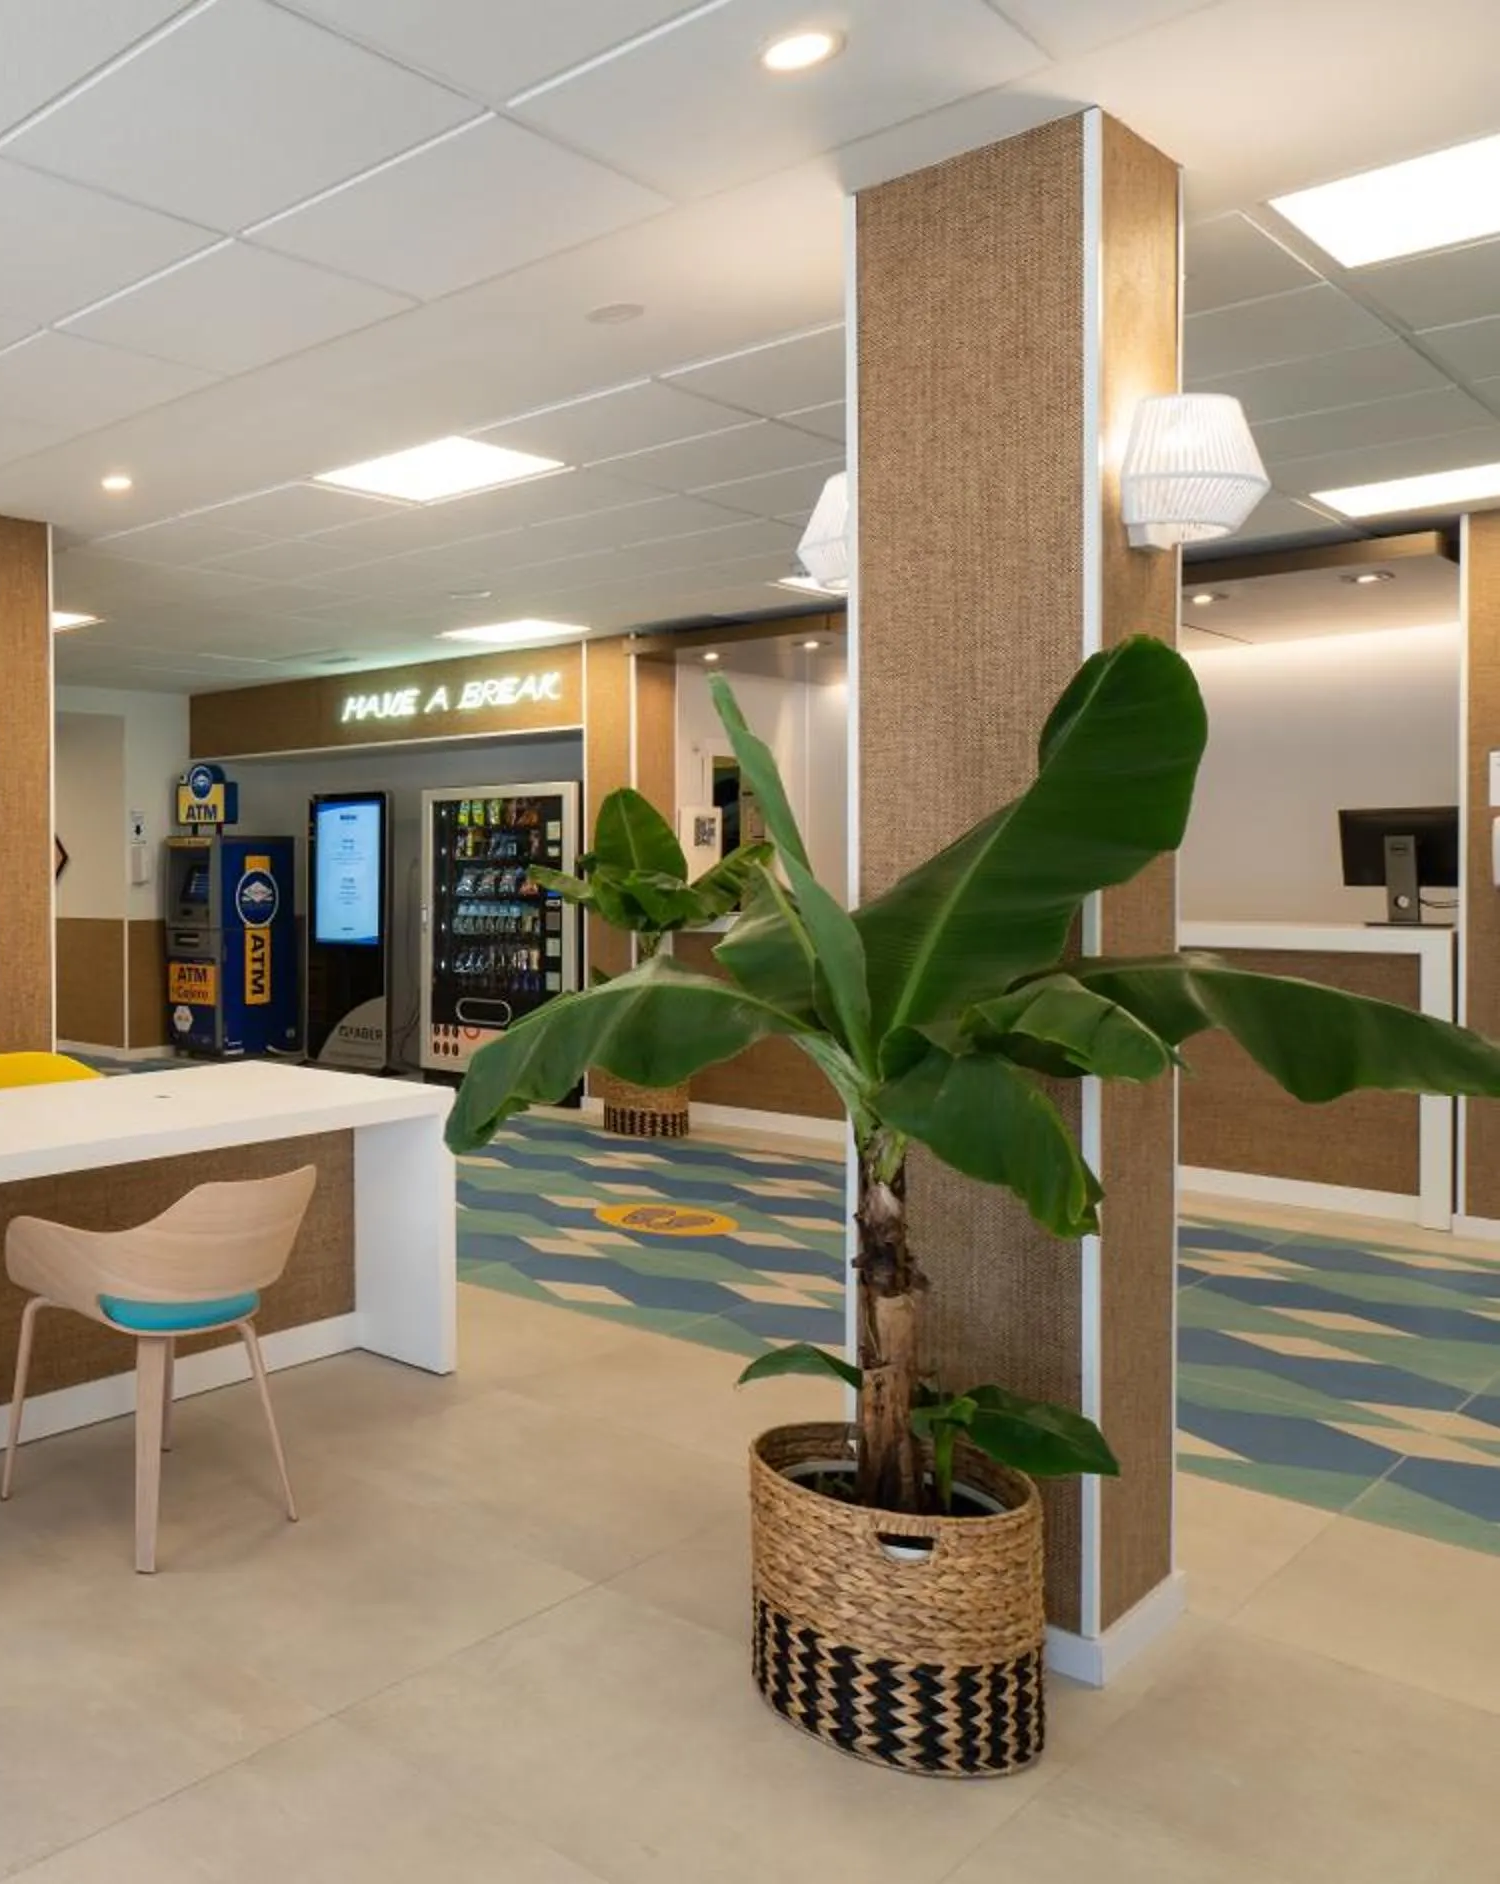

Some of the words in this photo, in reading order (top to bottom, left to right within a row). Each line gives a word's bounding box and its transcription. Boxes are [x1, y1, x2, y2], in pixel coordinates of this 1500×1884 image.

[341, 688, 420, 723] HAVE
[424, 684, 449, 713] A
[456, 671, 561, 710] BREAK
[186, 803, 218, 821] ATM
[177, 966, 208, 983] ATM
[251, 933, 265, 996] ATM
